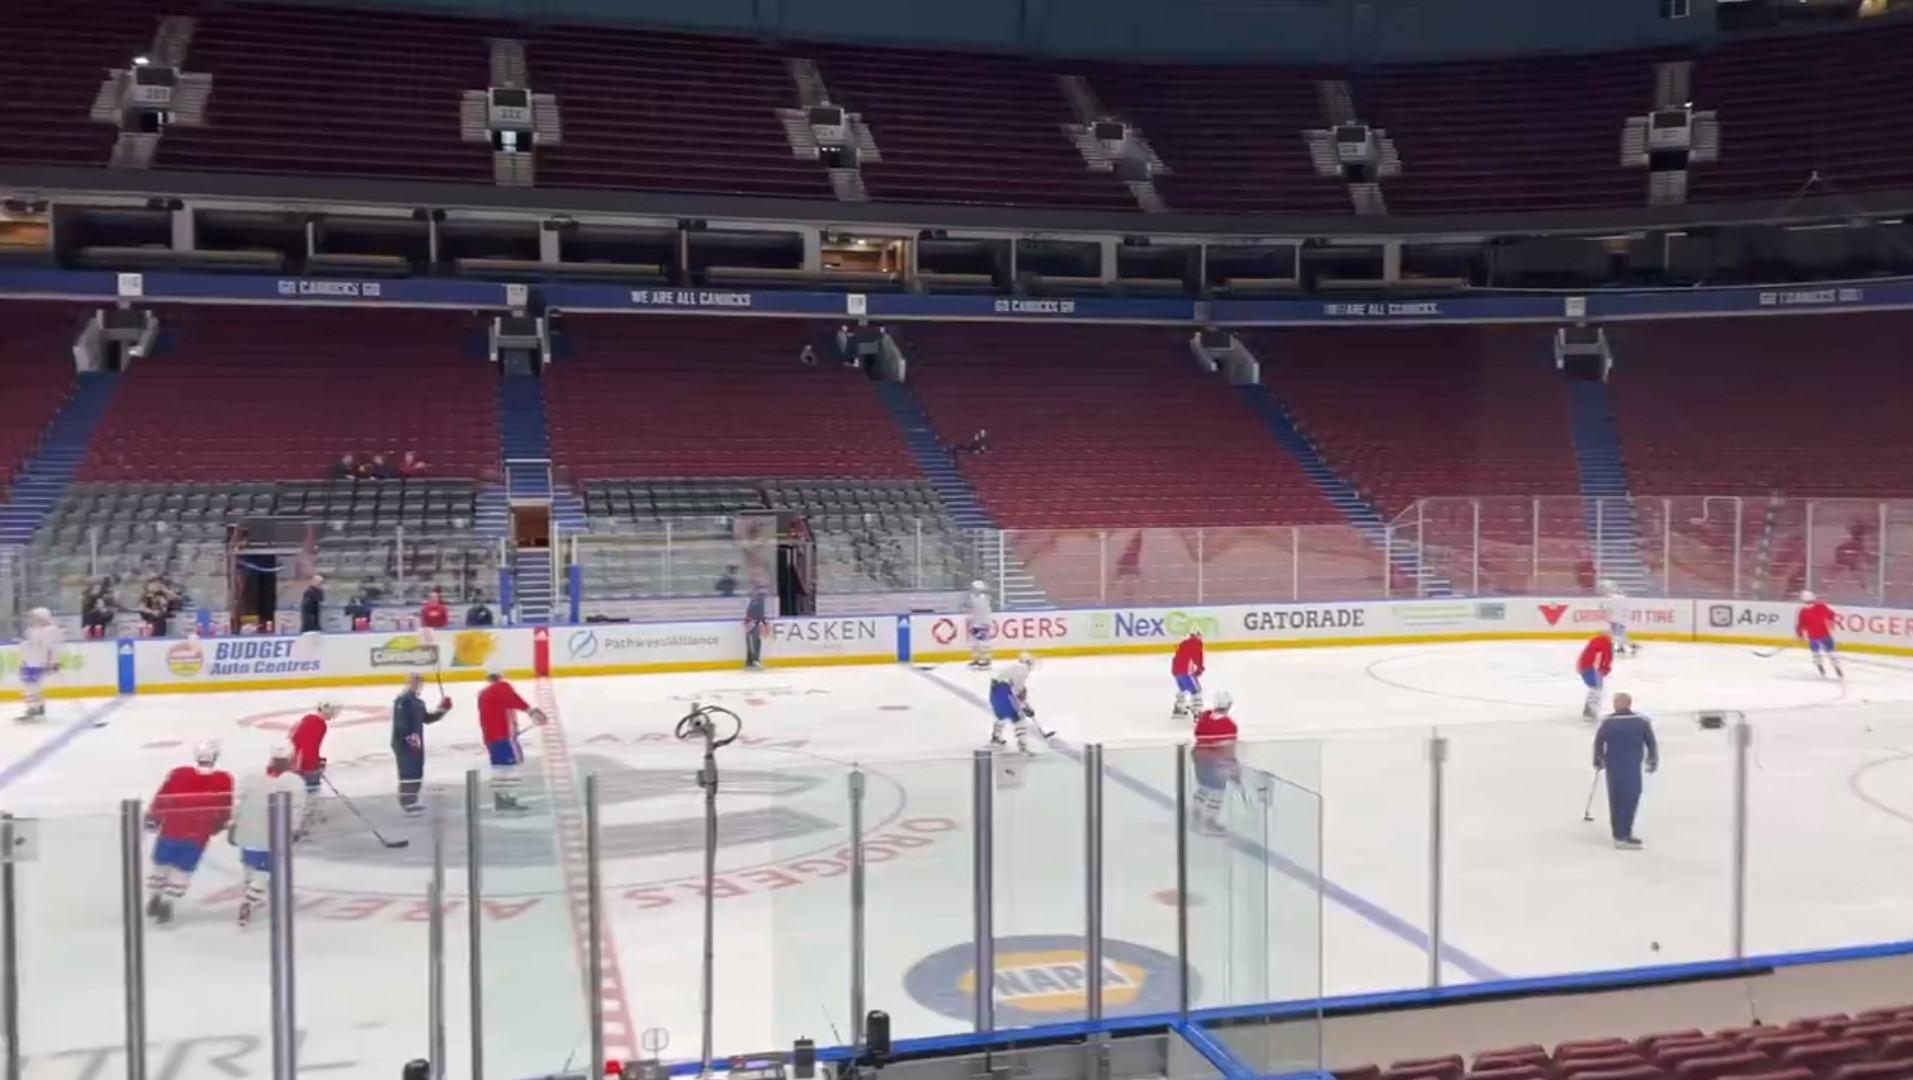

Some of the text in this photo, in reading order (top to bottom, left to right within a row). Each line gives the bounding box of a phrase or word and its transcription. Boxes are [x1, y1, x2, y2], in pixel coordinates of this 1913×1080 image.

[631, 290, 649, 303] WE
[653, 291, 674, 304] ARE
[677, 292, 696, 305] ALL
[1243, 608, 1365, 630] GATORADE
[772, 620, 877, 641] FASKEN
[215, 639, 296, 660] BUDGET
[210, 661, 250, 676] Auto
[254, 660, 321, 674] Centres
[992, 961, 1131, 998] NAPA
